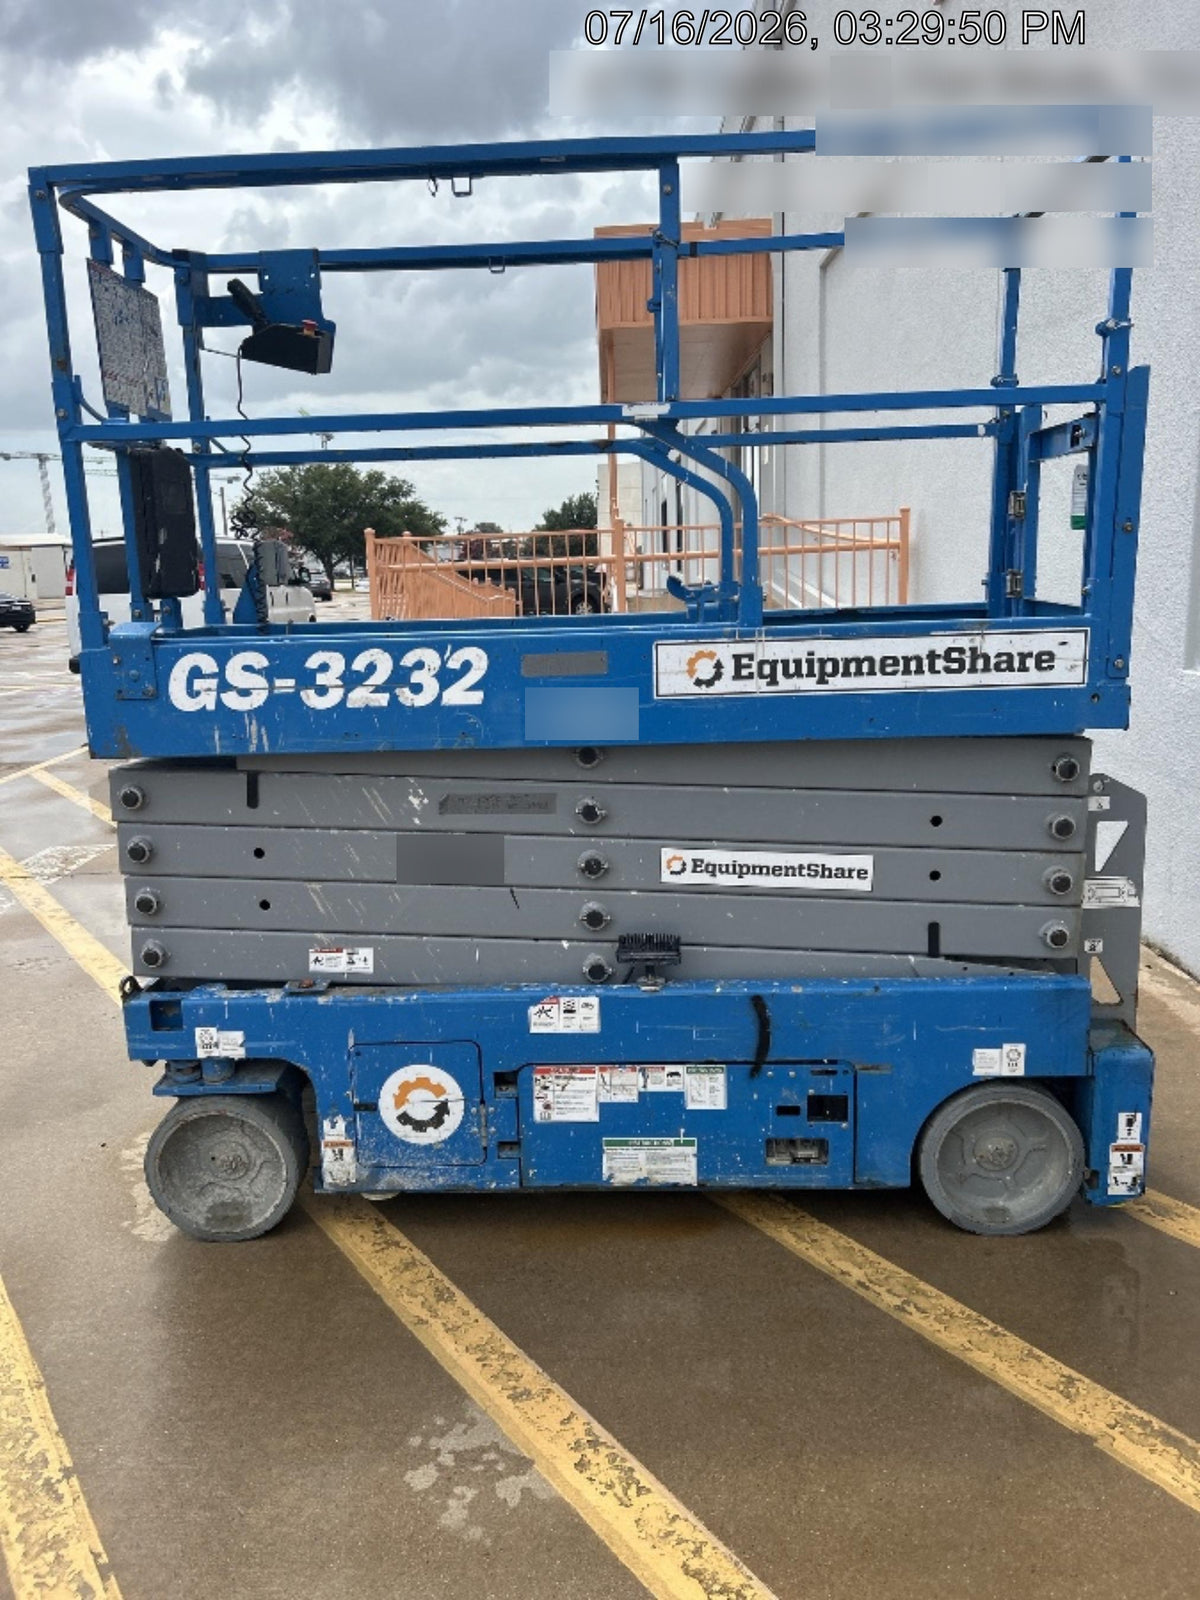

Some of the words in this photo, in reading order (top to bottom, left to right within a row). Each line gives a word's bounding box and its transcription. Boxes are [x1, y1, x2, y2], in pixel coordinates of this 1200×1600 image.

[168, 647, 487, 711] GS-3232
[731, 647, 1056, 686] EquipmentShare
[691, 858, 868, 881] EquipmentShare
